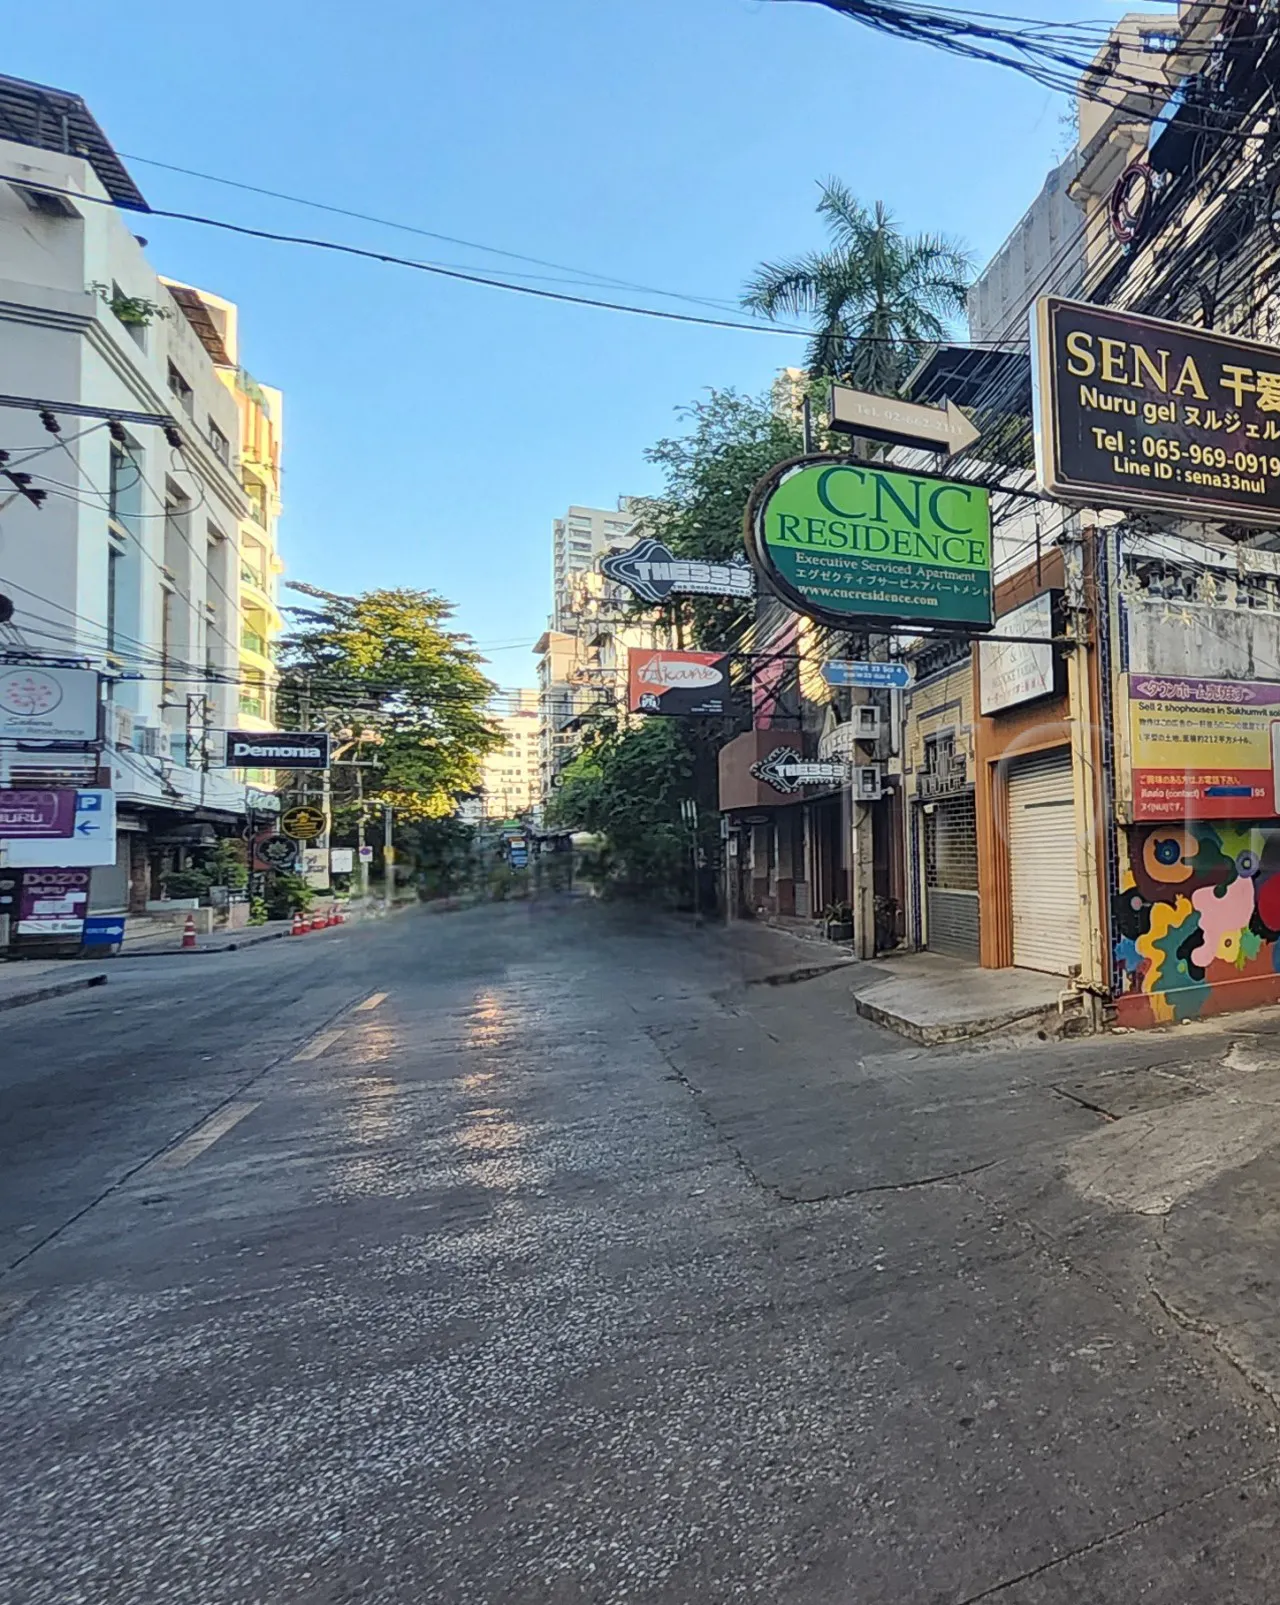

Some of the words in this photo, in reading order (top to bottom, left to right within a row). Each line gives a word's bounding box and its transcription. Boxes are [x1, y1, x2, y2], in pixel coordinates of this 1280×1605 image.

[1066, 331, 1209, 400] SENA
[1080, 385, 1136, 416] Nuru
[1143, 402, 1176, 424] gel
[1091, 427, 1124, 453] Tel
[1113, 456, 1151, 476] Line
[1154, 463, 1173, 480] ID
[1184, 471, 1266, 494] sena33nul
[816, 466, 973, 535] CNC
[776, 513, 986, 566] RESIDENCE
[795, 552, 858, 570] Executive
[861, 560, 912, 576] Serviced
[916, 567, 976, 583] Apartment
[797, 585, 939, 606] www.cncresidence.com
[638, 653, 718, 683] Akane
[1138, 702, 1156, 711] Sell
[1157, 703, 1163, 711] 2
[1164, 704, 1215, 714] shophouses
[1217, 706, 1225, 714] in
[1226, 706, 1268, 716] Sukhumvit
[1269, 709, 1280, 717] soi
[234, 743, 321, 758] Demonia
[80, 797, 97, 809] P
[1165, 788, 1199, 799] (contact)
[22, 873, 88, 885] DOZO
